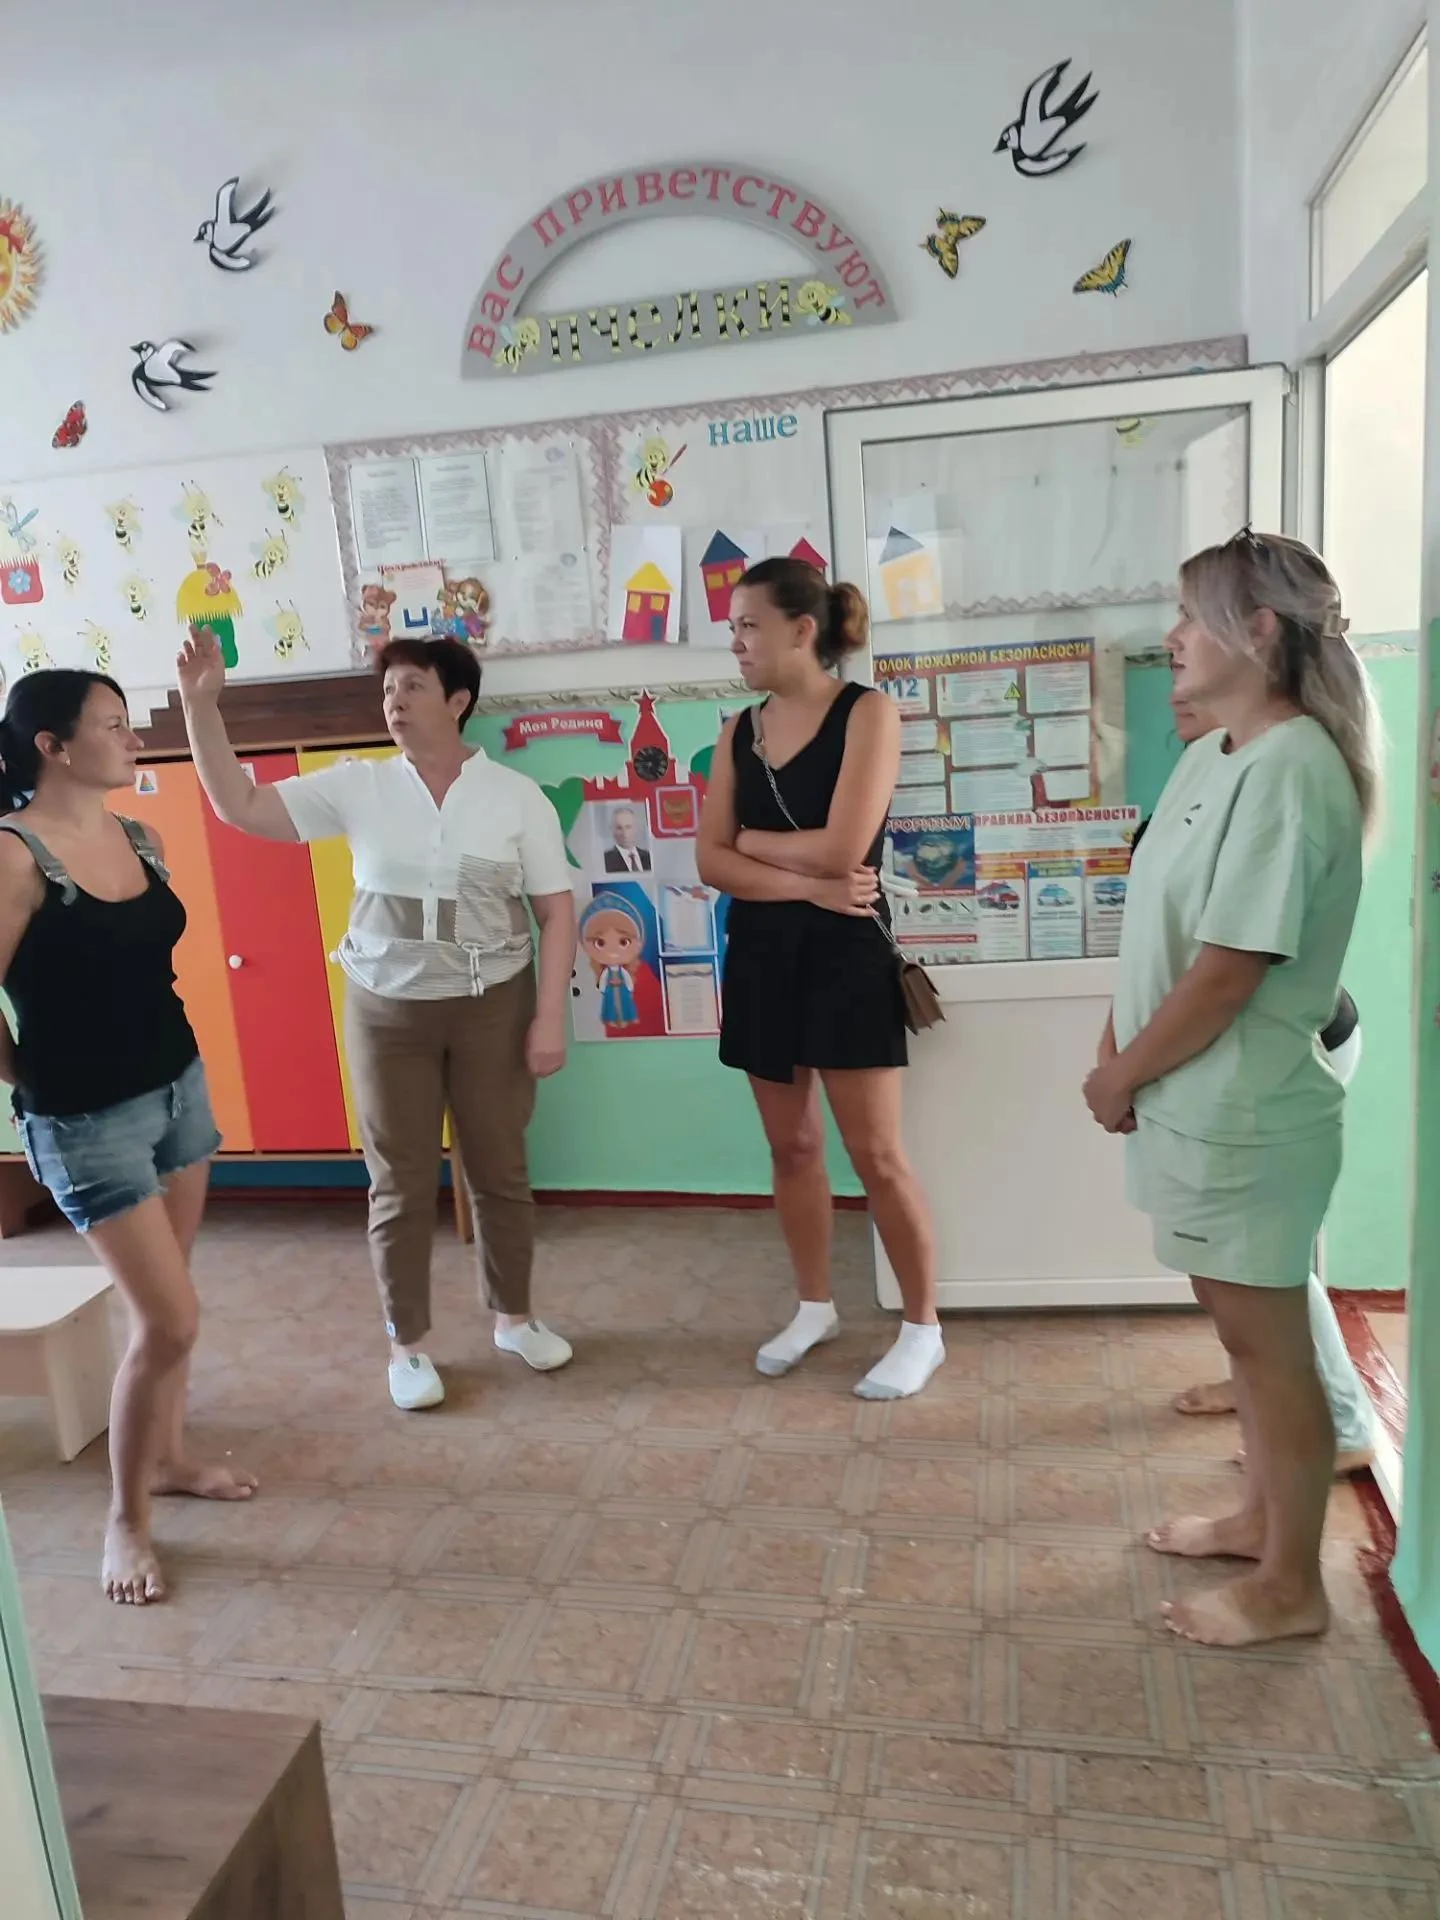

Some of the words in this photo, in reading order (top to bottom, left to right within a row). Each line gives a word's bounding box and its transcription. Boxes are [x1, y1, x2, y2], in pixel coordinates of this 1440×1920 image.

[872, 657, 912, 673] ГОЛОК
[915, 649, 986, 670] ПОЖАРНОЙ
[990, 641, 1090, 663] БЕЗОПАСНОСТИ
[879, 676, 920, 699] 112
[520, 720, 548, 735] Моя
[551, 717, 603, 730] Родина
[974, 813, 1032, 827] ПРАВИЛА
[1036, 807, 1137, 824] БЕЗОПАСНОСТИ
